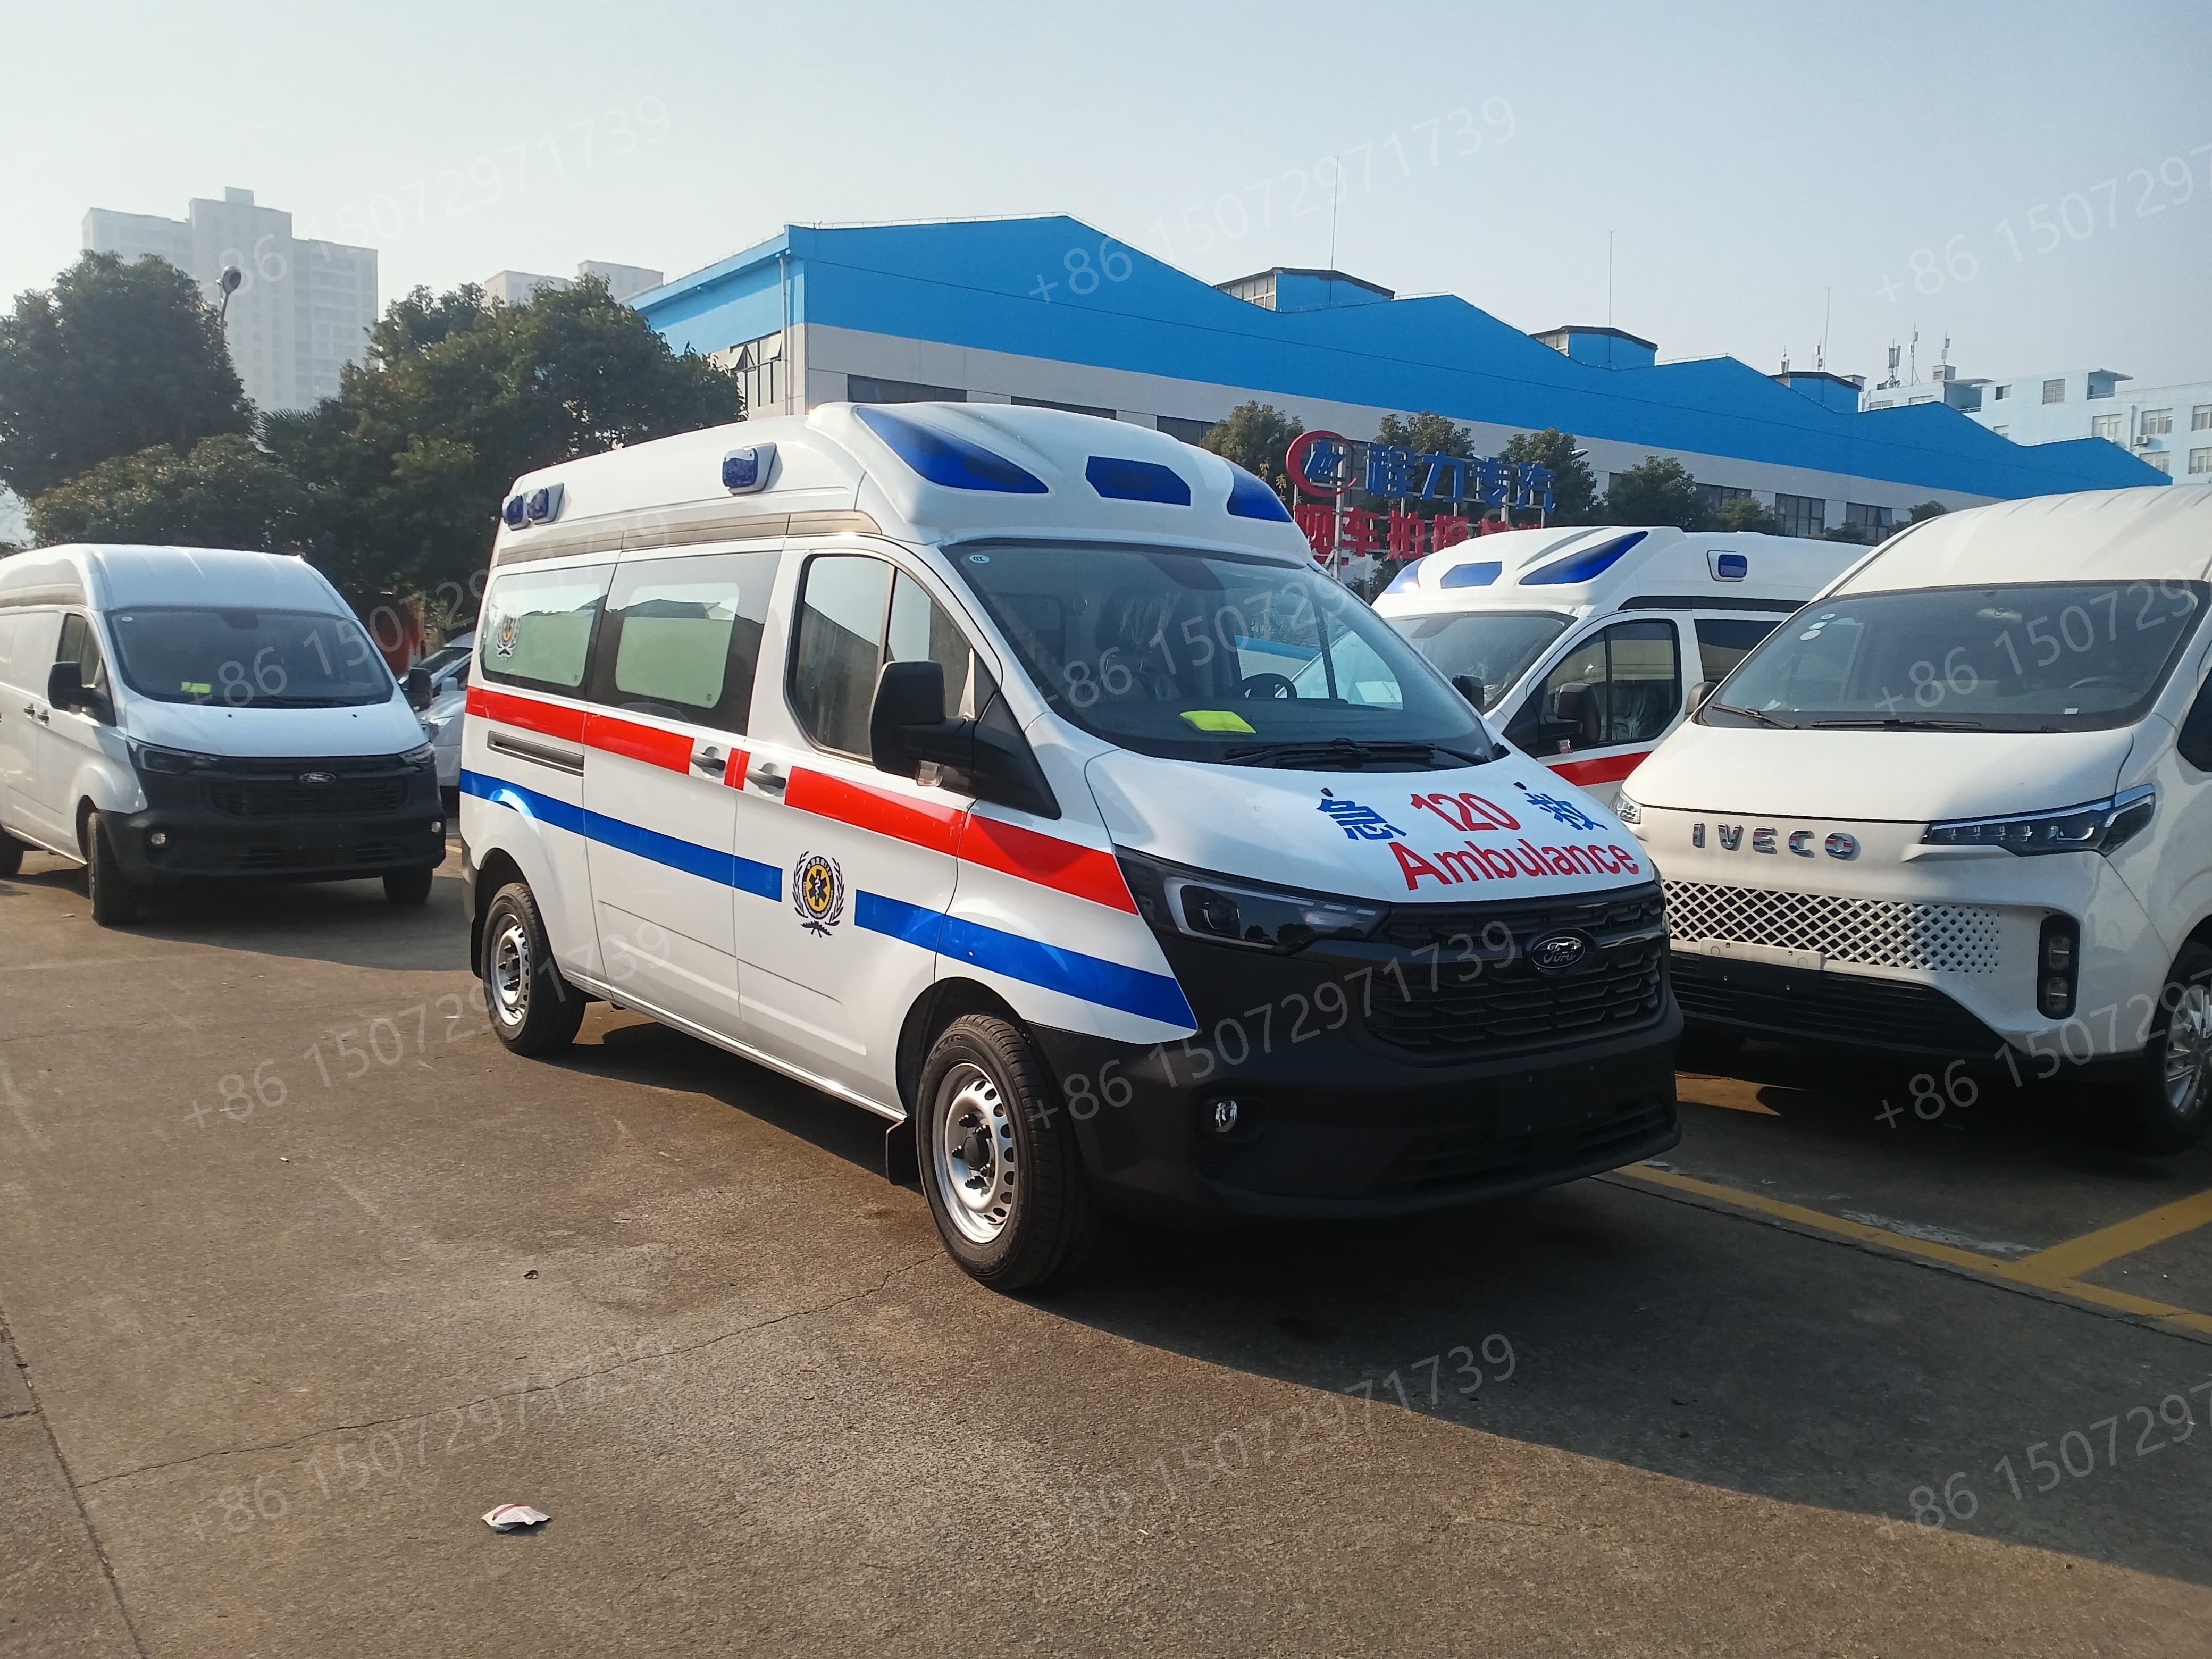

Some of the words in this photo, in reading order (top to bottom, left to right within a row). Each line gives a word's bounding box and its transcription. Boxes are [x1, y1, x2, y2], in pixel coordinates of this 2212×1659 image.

[1365, 442, 1557, 513] 程力专汽
[1293, 504, 1541, 560] 现车拍摄
[1316, 797, 1407, 841] 急
[1411, 793, 1521, 832] 120
[1526, 792, 1608, 831] 救
[1692, 822, 1857, 859] IVECO
[1388, 839, 1639, 891] Ambulance
